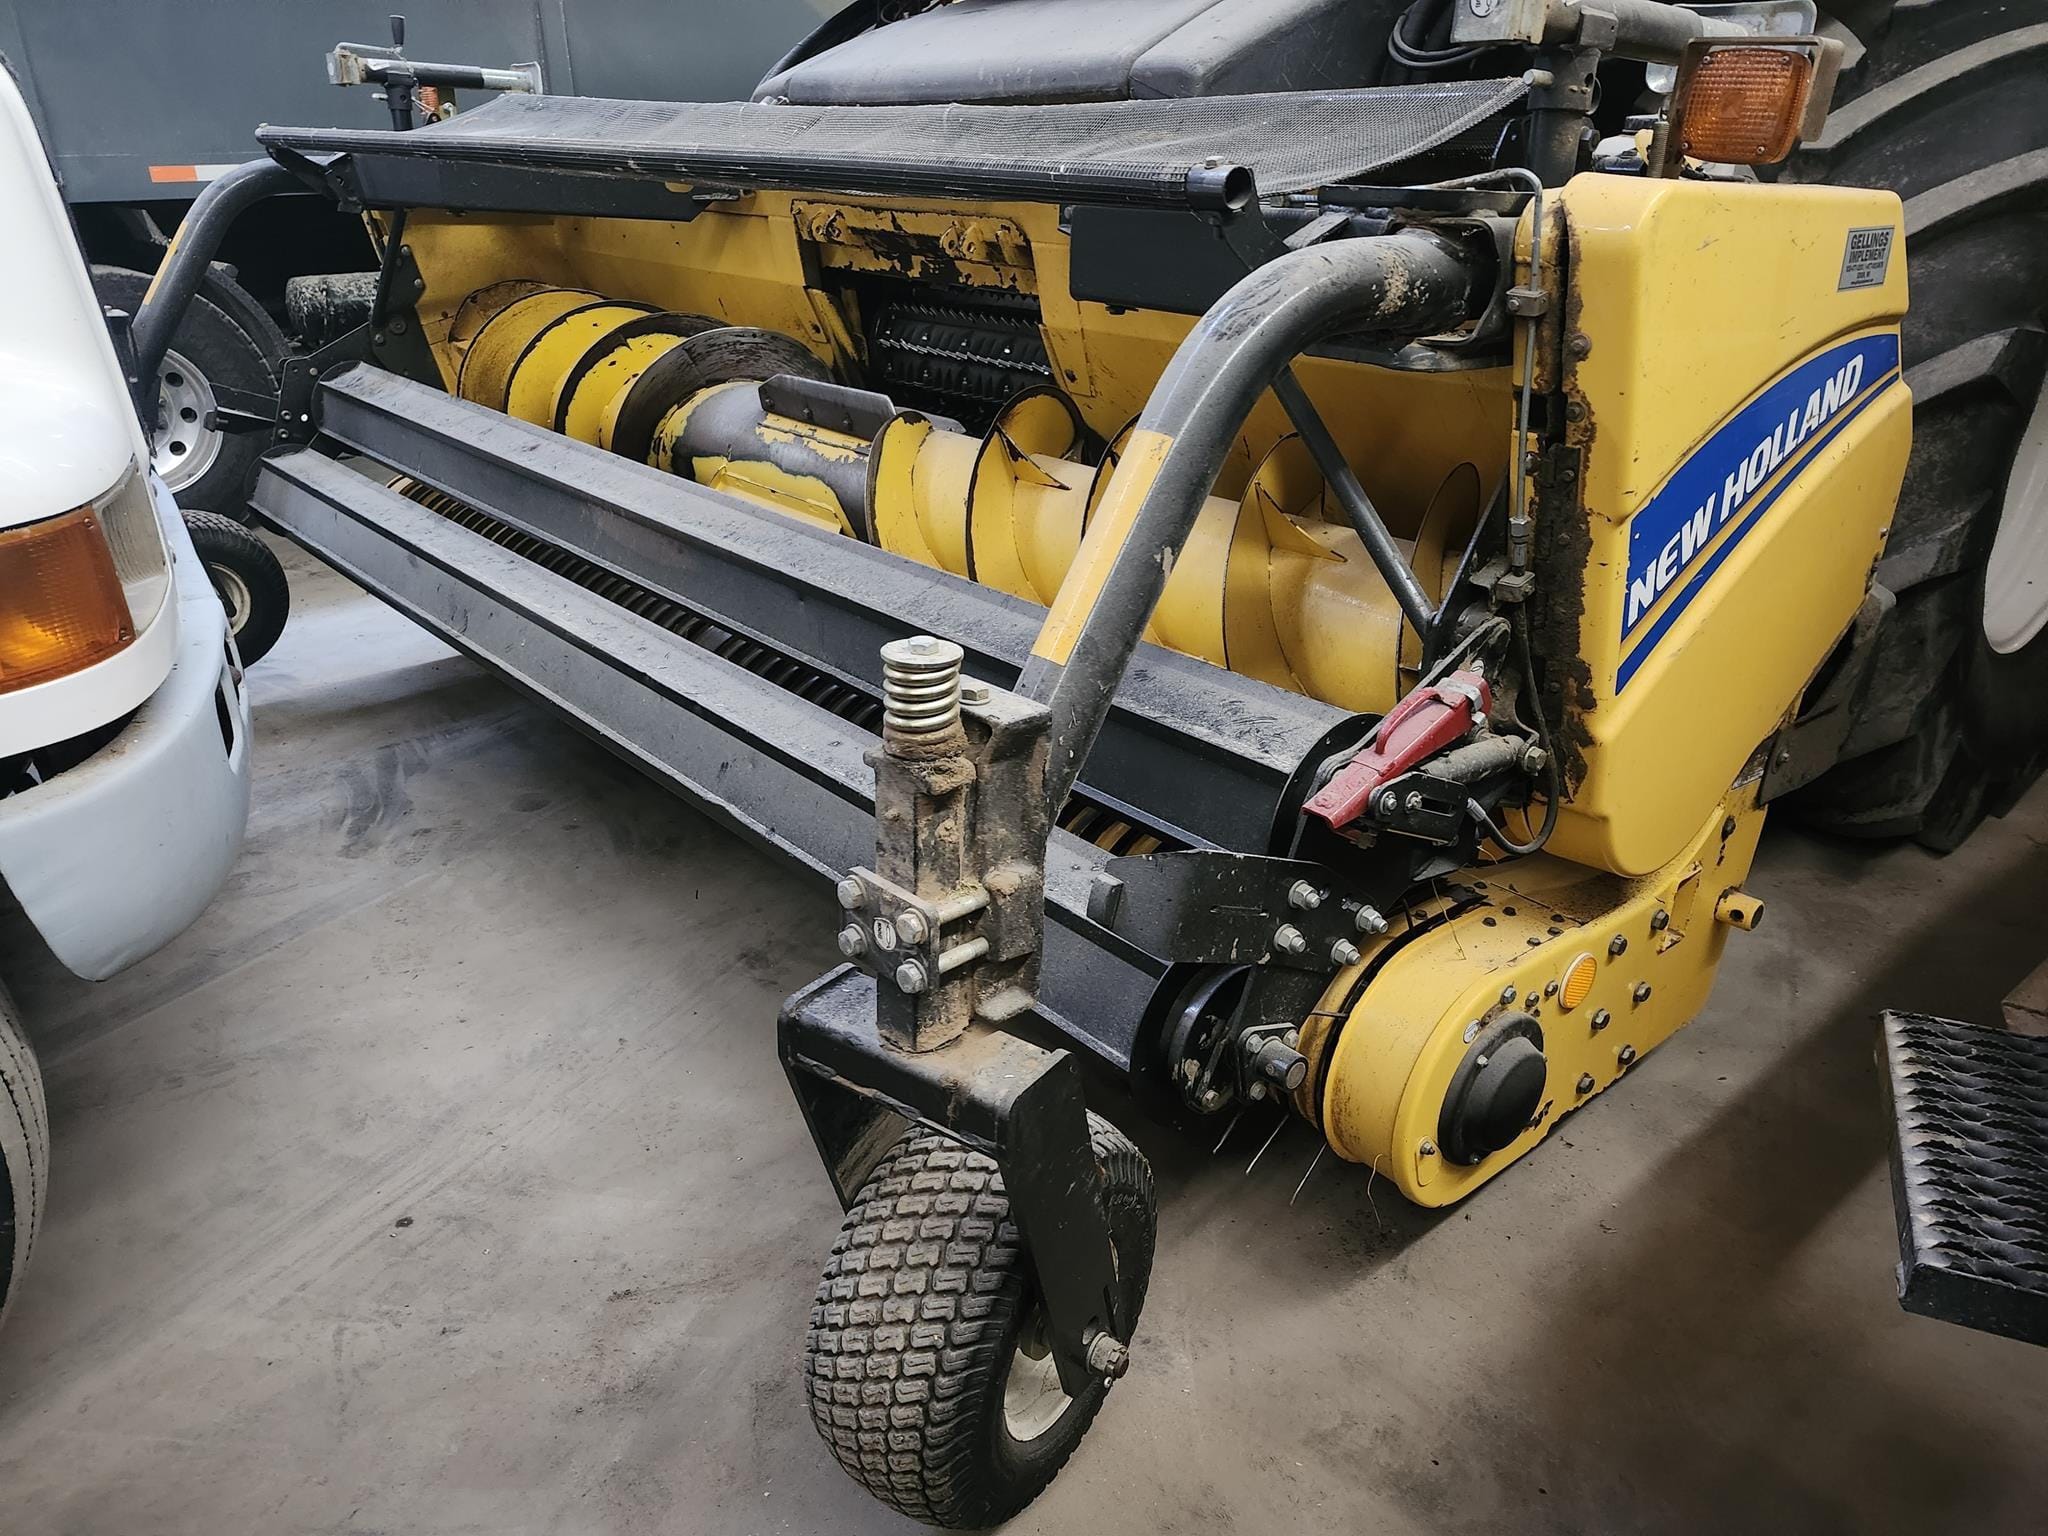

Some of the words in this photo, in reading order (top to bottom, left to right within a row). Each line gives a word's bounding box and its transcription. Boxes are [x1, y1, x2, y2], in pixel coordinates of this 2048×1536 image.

[1850, 231, 1889, 250] GELLINGS
[1848, 247, 1886, 264] IMPLEMENT
[1627, 492, 1716, 628] NEW
[1719, 353, 1864, 524] HOLLAND
